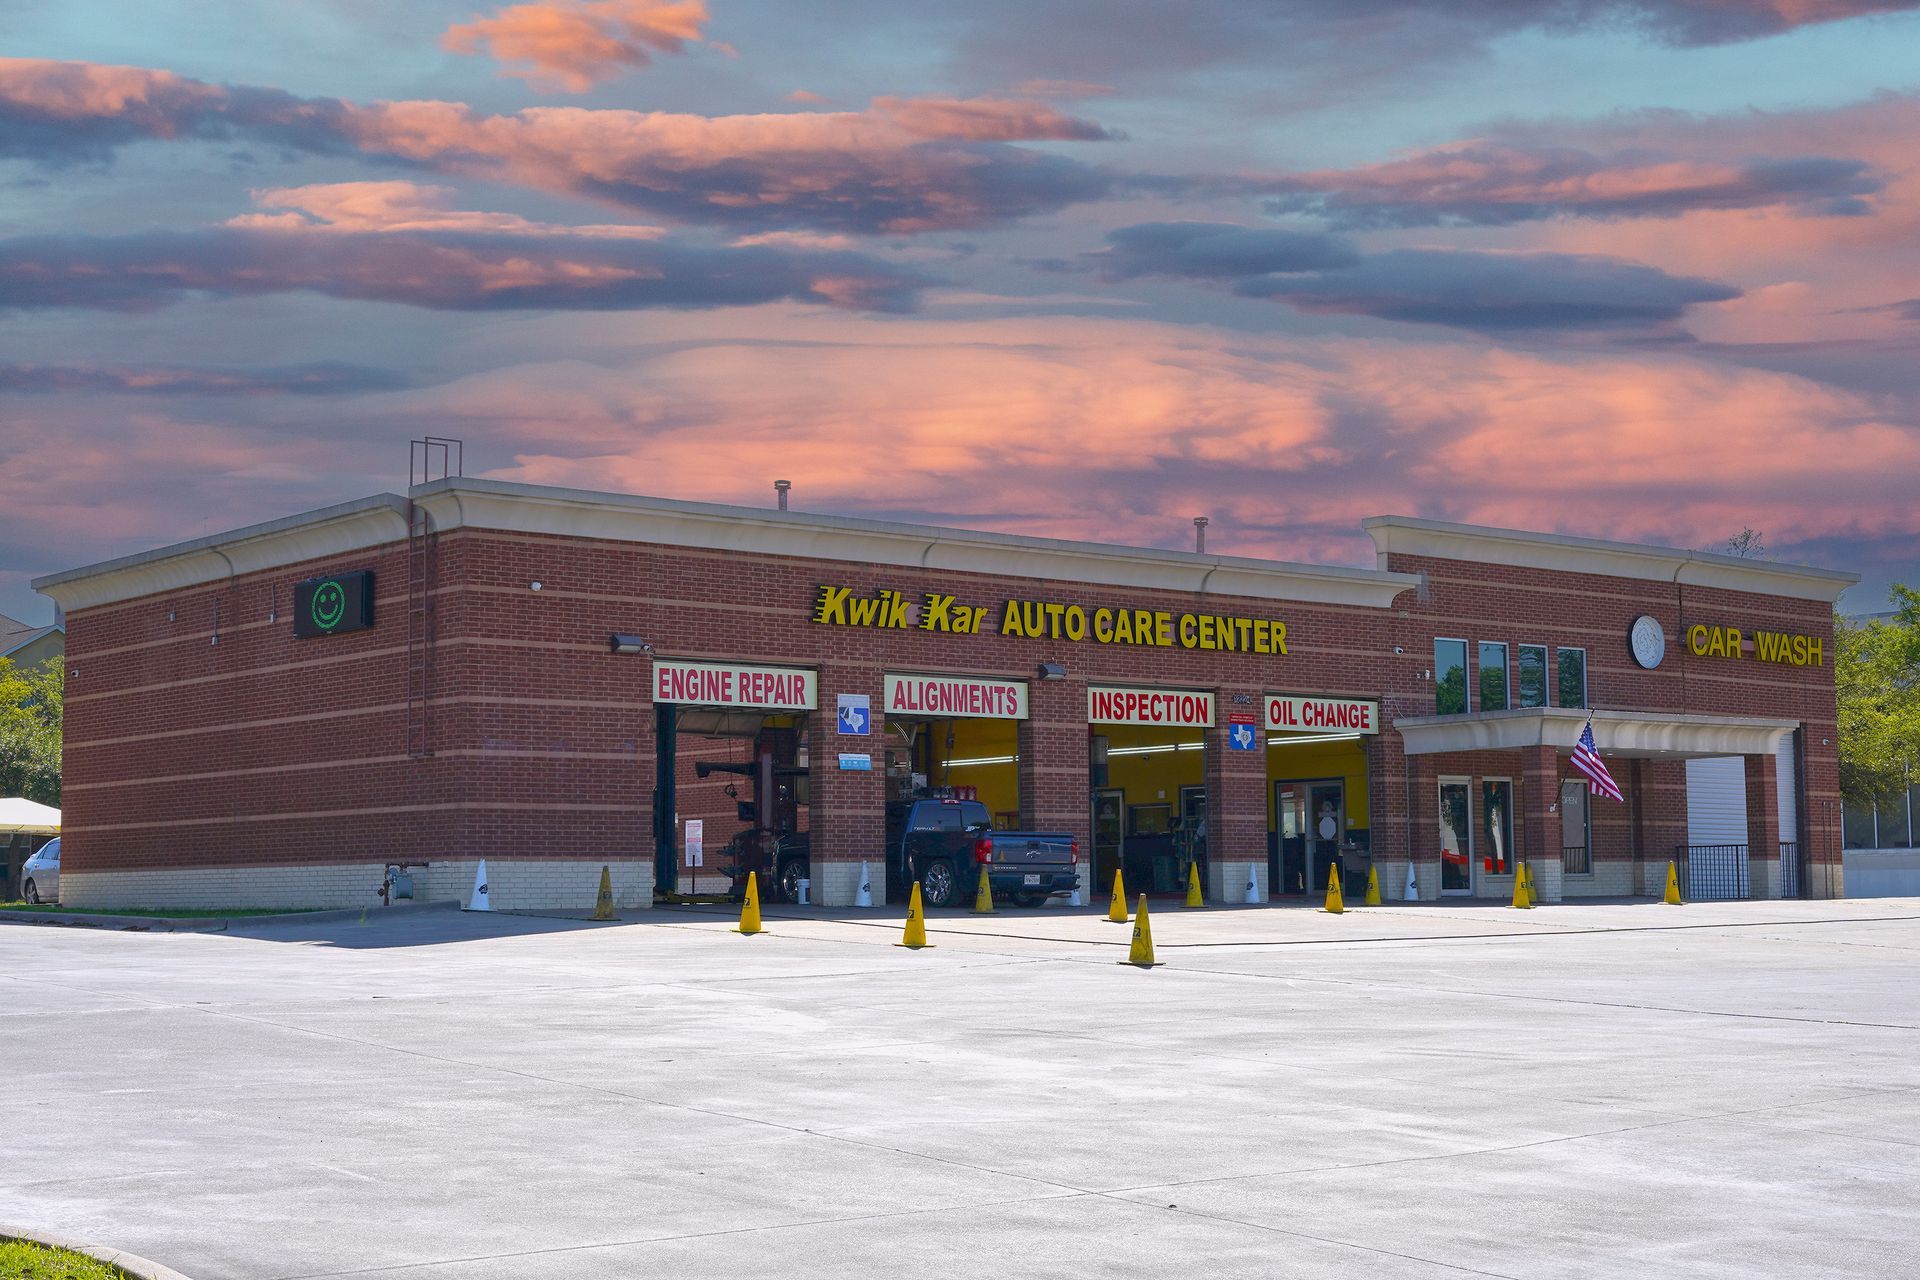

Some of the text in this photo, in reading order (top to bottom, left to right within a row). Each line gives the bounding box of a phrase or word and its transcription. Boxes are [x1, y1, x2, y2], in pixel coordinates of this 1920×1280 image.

[813, 585, 1290, 656] Kwik Kar AUTO CARE CENTER
[1686, 623, 1824, 668] CAR WASH
[658, 667, 806, 706] ENGINE REPAIR
[893, 680, 1018, 716] ALIGNMENTS
[1091, 692, 1209, 724] INSPECTION
[1270, 699, 1371, 729] OIL CHANGE
